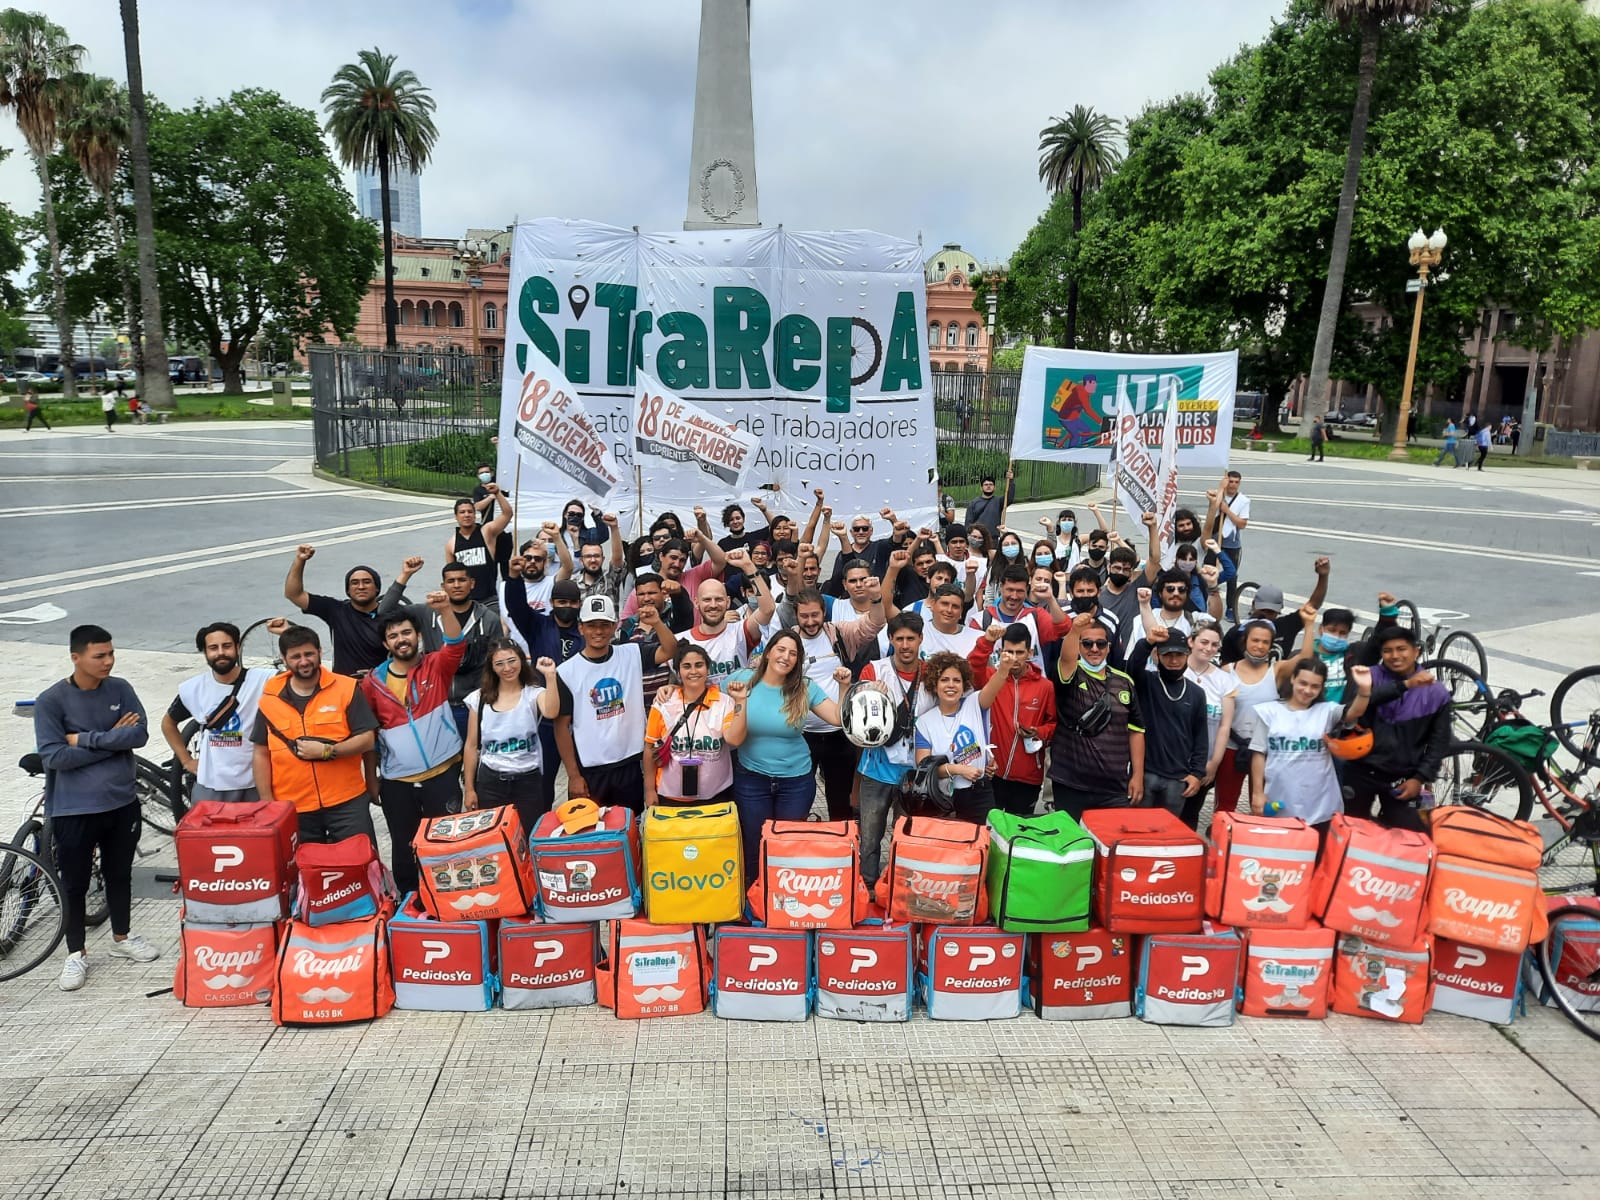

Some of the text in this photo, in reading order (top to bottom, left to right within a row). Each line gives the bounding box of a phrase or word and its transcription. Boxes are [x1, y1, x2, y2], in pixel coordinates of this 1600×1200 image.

[516, 276, 922, 413] SiTraRepA
[517, 371, 572, 422] 18 DE
[1179, 401, 1215, 410] OVENES
[638, 392, 663, 437] 18
[666, 402, 685, 419] DE
[771, 413, 917, 444] Trabajadores
[650, 442, 687, 460] CORIENTE
[661, 420, 747, 469] DICIEMBRE
[518, 429, 555, 459] CORRIENTE
[556, 457, 588, 483] SINDICAL
[754, 446, 875, 471] Aplicación
[189, 878, 270, 892] PedidosYa
[651, 869, 726, 891] Glovo
[776, 868, 842, 897] Rappi
[1350, 866, 1420, 904] Rappi
[549, 888, 622, 903] PedidosYa
[1120, 890, 1194, 905] PedidosYa
[1443, 887, 1521, 922] Rappi
[1500, 924, 1522, 944] 35
[194, 943, 264, 973] Rappi
[294, 947, 364, 980] Rappi
[402, 968, 472, 981] PedidosYa
[510, 968, 585, 986] PedidosYa
[725, 977, 798, 991] PedidosYa
[828, 977, 896, 991] PedidosYa
[945, 976, 1012, 989] PedidosYa
[1054, 974, 1121, 990] PedidosYa
[1158, 985, 1225, 1000] PedidosYa
[303, 1009, 343, 1018] BA 453 BK
